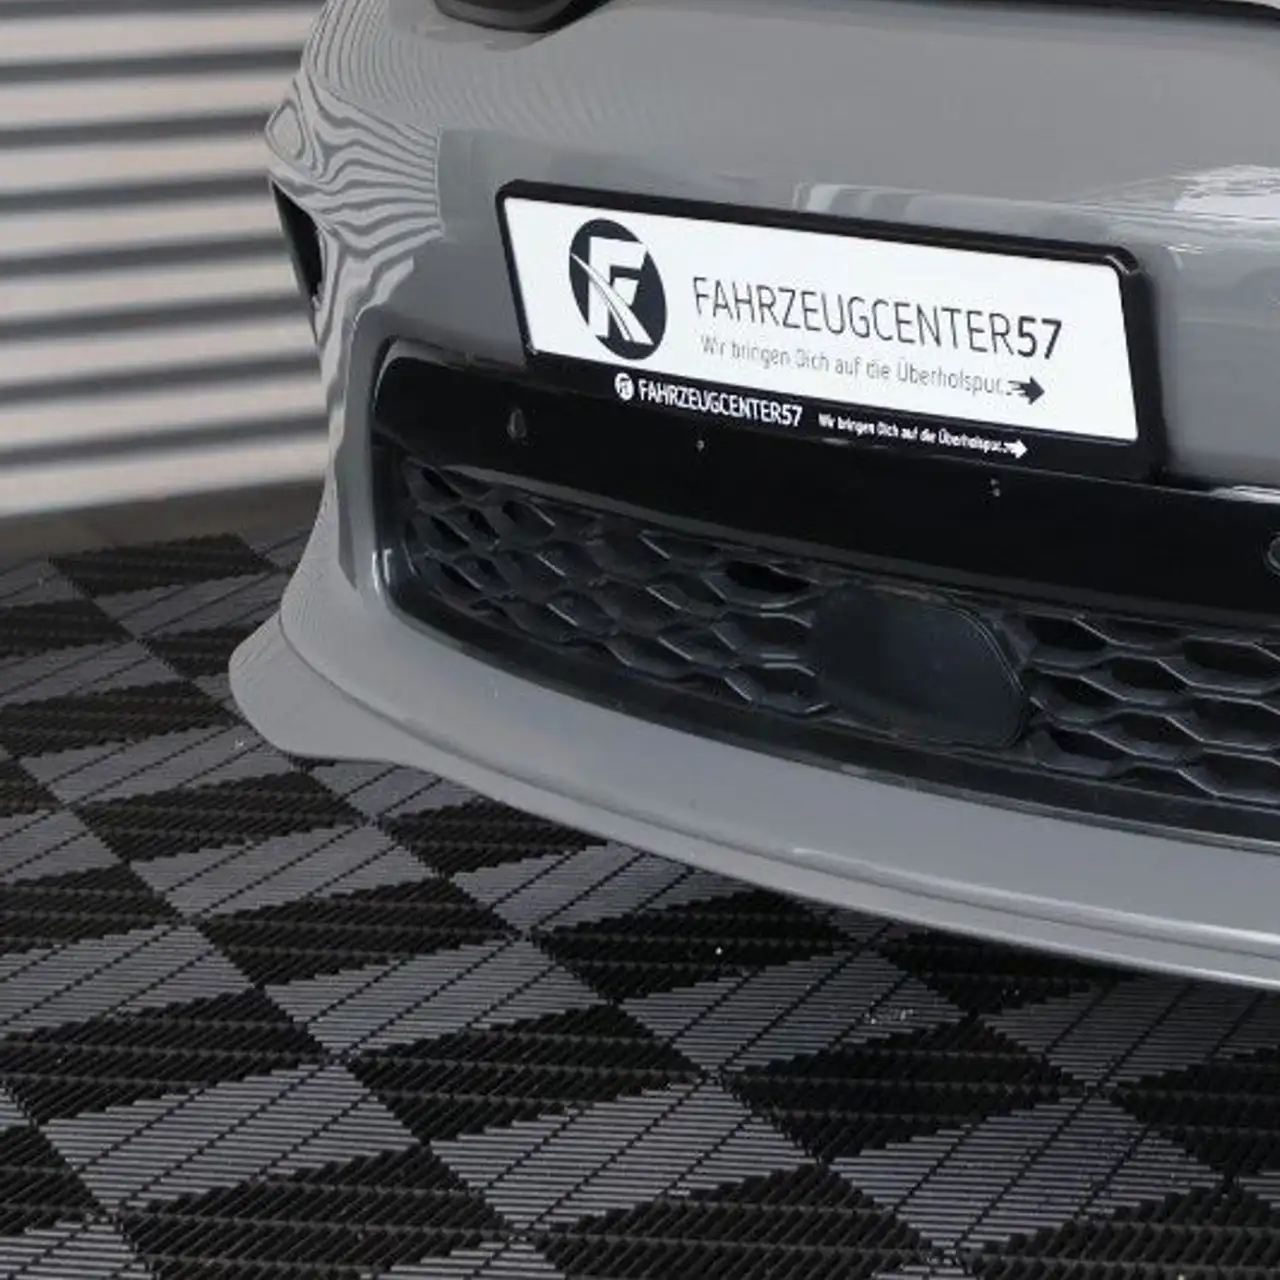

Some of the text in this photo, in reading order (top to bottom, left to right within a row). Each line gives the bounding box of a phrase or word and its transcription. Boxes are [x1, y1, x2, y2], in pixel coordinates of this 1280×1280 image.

[693, 276, 1063, 360] FAHRZEUGCENTER57
[701, 335, 726, 356] Wir
[731, 341, 791, 370] bringen
[834, 356, 860, 378] auf
[638, 379, 804, 427] FAHRZEUGCENTER57
